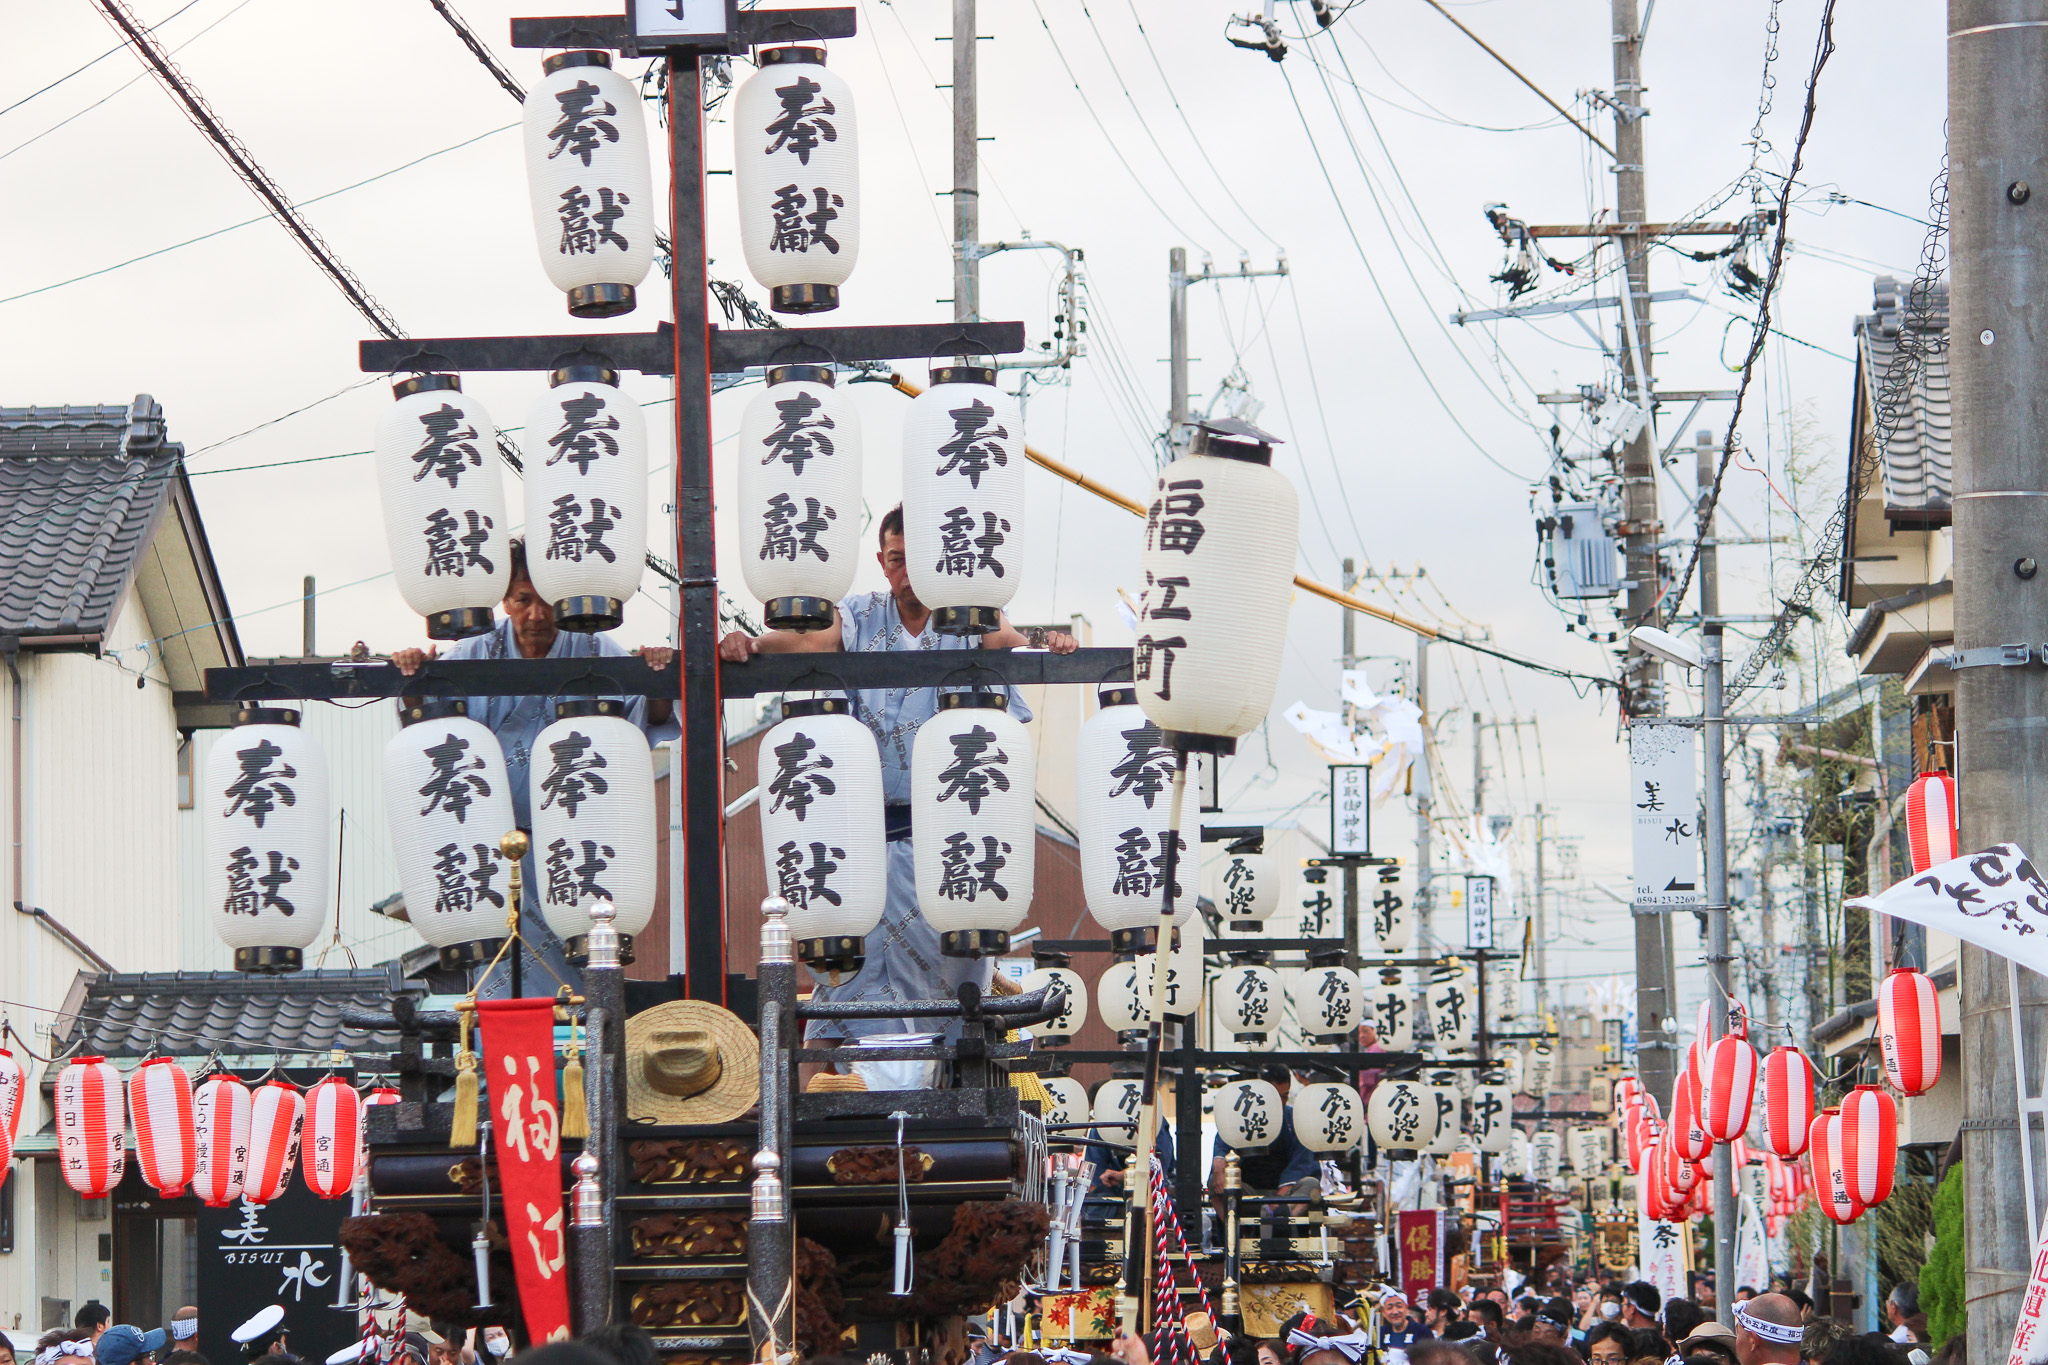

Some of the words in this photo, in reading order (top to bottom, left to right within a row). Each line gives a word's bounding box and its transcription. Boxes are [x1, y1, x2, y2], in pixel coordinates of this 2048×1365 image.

[1138, 479, 1206, 702] 福江町
[1341, 769, 1362, 847] 石取御神事
[1637, 885, 1654, 894] tel.
[1637, 895, 1696, 904] 0594-23-2269
[316, 1135, 332, 1173] 宮通
[501, 1055, 570, 1343] 福江
[224, 1252, 285, 1264] BISUI
[1406, 1224, 1435, 1281] 優勝
